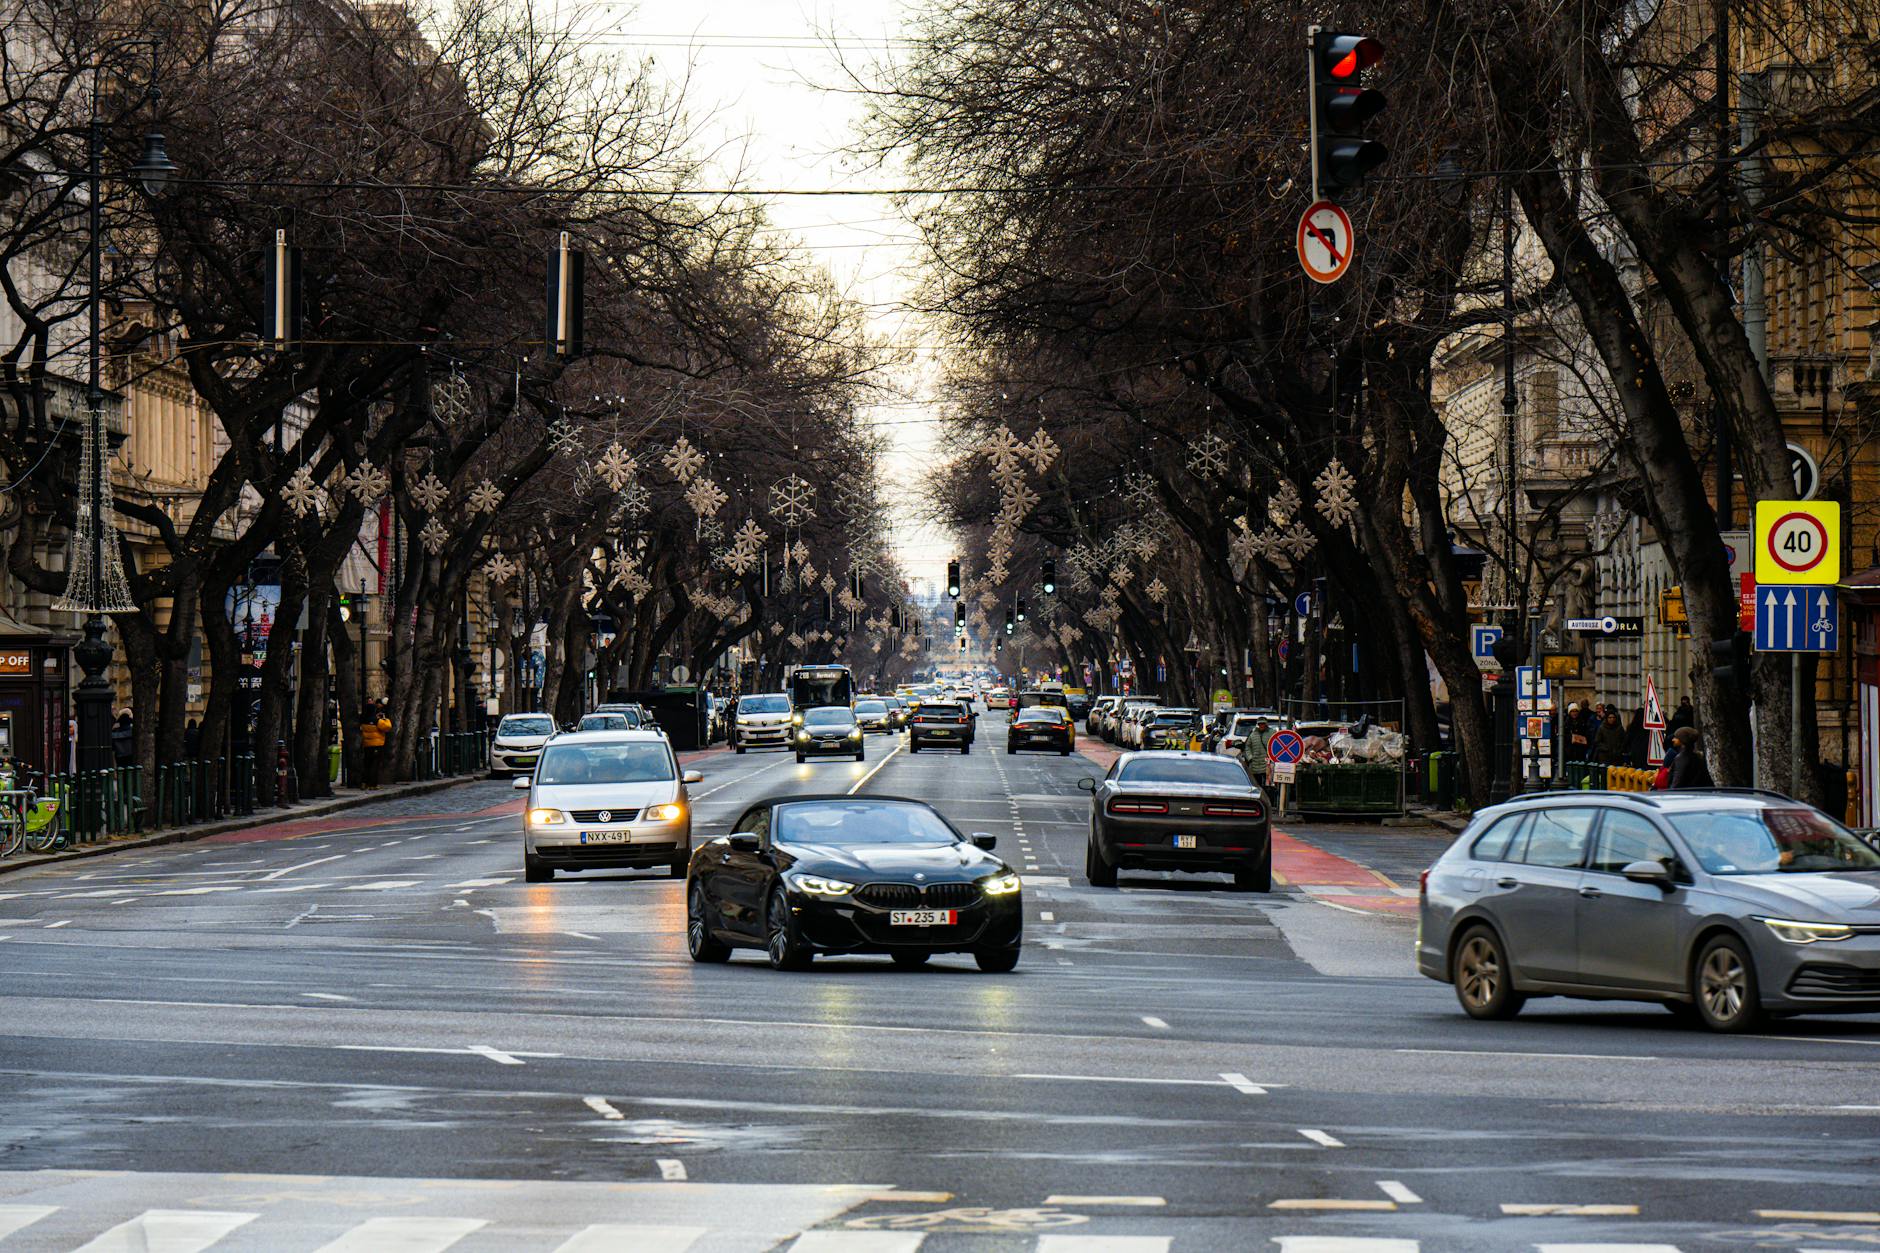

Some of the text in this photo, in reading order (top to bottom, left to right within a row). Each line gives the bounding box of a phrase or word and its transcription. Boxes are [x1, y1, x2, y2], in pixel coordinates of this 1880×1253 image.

[1783, 530, 1811, 553] 40
[1481, 632, 1496, 654] P
[8, 656, 29, 666] OFF
[587, 832, 628, 841] NXX-491
[892, 912, 947, 923] ST 235 A
